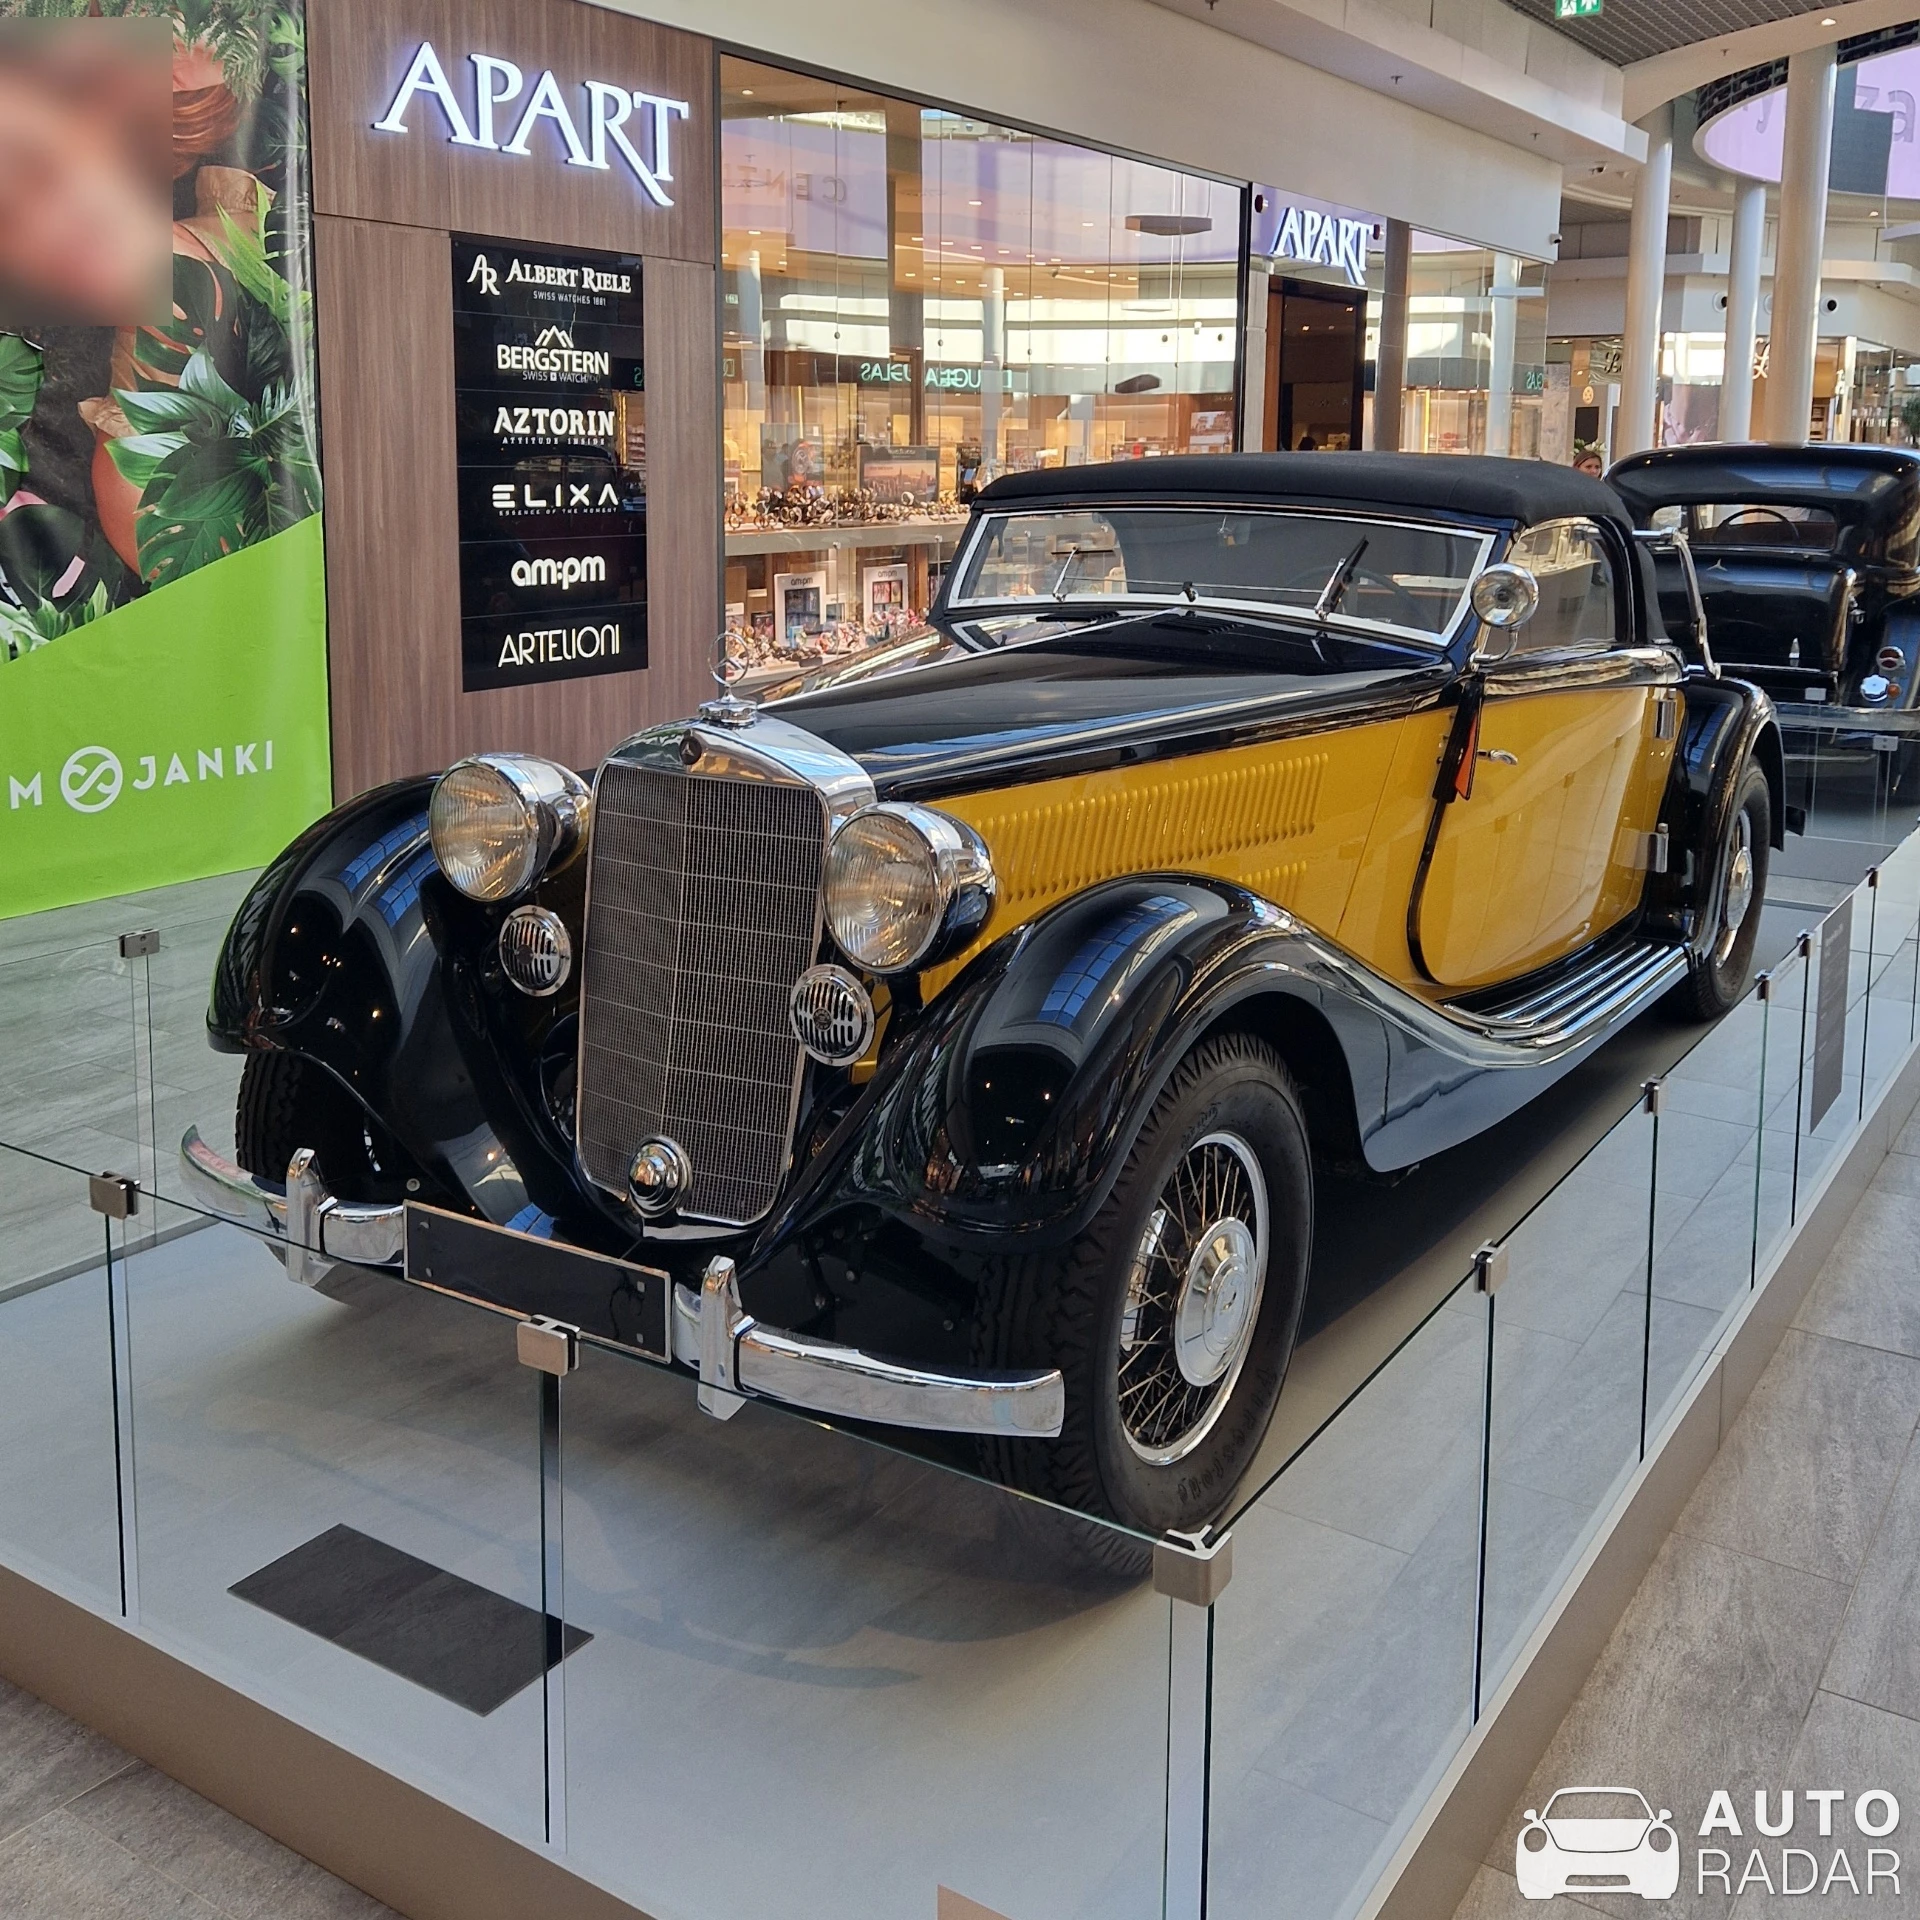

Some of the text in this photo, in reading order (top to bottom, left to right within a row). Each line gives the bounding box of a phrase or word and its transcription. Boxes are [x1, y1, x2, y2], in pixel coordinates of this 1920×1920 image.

[374, 41, 689, 206] APART
[1269, 206, 1374, 286] APART
[505, 258, 632, 293] ALBERT RIELE
[533, 290, 556, 301] SWISS
[558, 292, 591, 304] WATCHES
[496, 344, 609, 375] BERGSTERN
[522, 371, 548, 381] SWISS
[493, 406, 615, 436] AZTORIN
[502, 436, 559, 445] ATTITUDE
[492, 483, 619, 508] ELIXA
[511, 555, 605, 590] am:pm
[498, 623, 619, 668] ARTELIONI
[132, 740, 273, 790] JANKI
